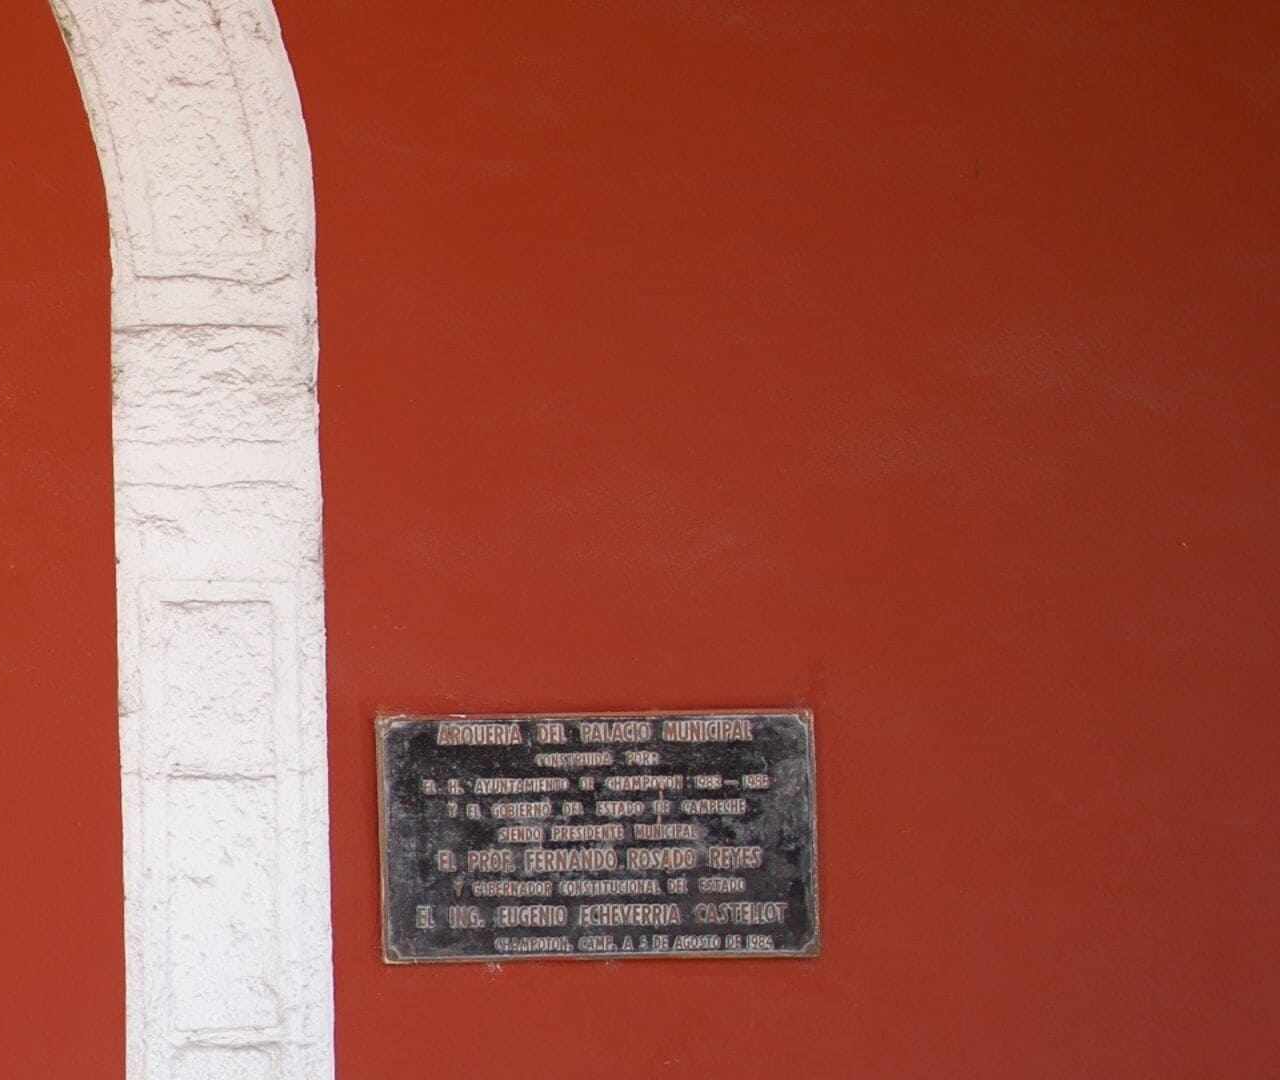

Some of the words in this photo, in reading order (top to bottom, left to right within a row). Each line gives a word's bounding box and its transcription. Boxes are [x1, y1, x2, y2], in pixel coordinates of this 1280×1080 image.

[436, 723, 523, 746] ARQUERIA
[536, 722, 567, 744] DEL
[579, 721, 651, 743] PALACIO
[662, 719, 753, 742] MUNICIPAL
[534, 752, 613, 767] CONSTRUIDA
[422, 779, 437, 795] EL
[474, 777, 570, 795] AYUNTAMIENTO
[579, 776, 595, 791] DE
[446, 802, 458, 818] Y
[466, 803, 481, 820] EL
[491, 801, 552, 818] GOBIERNO
[562, 801, 585, 817] DEL
[595, 800, 645, 817] ESTADO
[653, 799, 671, 814] DE
[680, 798, 746, 815] CAMPECHE
[498, 826, 543, 843] SIENDO
[551, 824, 624, 842] PRESIDENTE
[633, 823, 697, 840] MUNICIPAL
[437, 850, 456, 872] EL
[467, 849, 515, 873] PROF.
[524, 848, 618, 872] FERNANDO
[626, 847, 697, 871] ROSADO
[708, 846, 762, 869] REYES
[453, 881, 464, 897] Y
[472, 881, 552, 897] GOBERNADOR
[559, 879, 661, 896] CONSTITUCIONAL
[667, 878, 689, 894] DEL
[698, 877, 746, 893] ESTADO
[415, 905, 435, 929] EL
[448, 905, 485, 929] ING.
[497, 904, 568, 928] EUGENIO
[578, 903, 681, 927] ECHEVERRIA
[694, 902, 788, 926] CASTELLOT
[622, 935, 634, 951] A
[653, 935, 669, 951] DE
[672, 935, 722, 950] AGOSTO
[725, 934, 742, 950] DE
[746, 934, 775, 950] 1984
